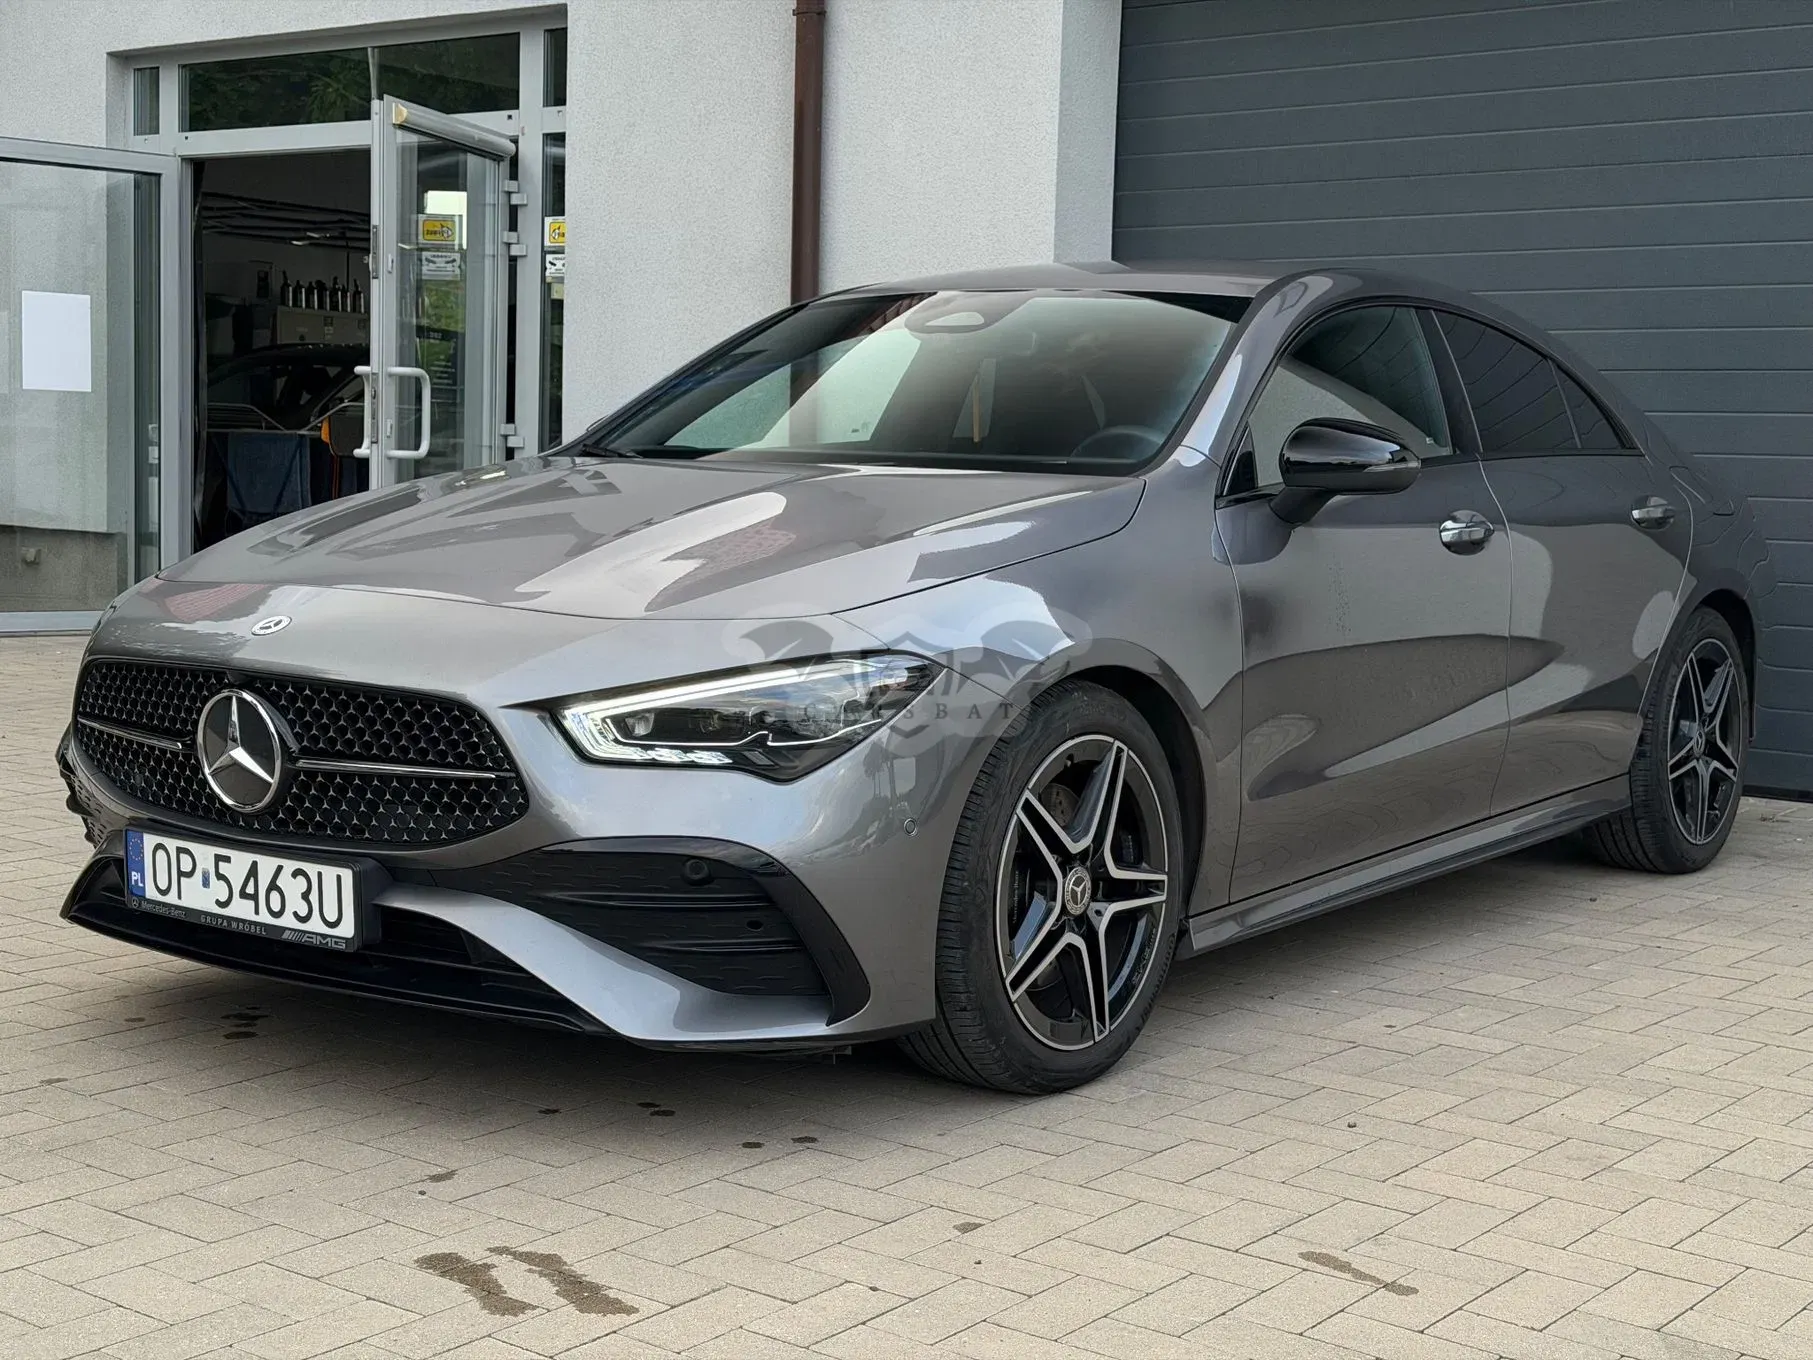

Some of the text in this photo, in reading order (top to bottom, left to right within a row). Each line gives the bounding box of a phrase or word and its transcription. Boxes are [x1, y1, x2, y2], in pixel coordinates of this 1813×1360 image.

[131, 870, 145, 888] PL
[151, 841, 343, 929] OP 5463U
[140, 899, 187, 919] Mercedes-Benz
[200, 914, 267, 936] GRUPA WRÓBEL
[301, 935, 347, 950] AMG
